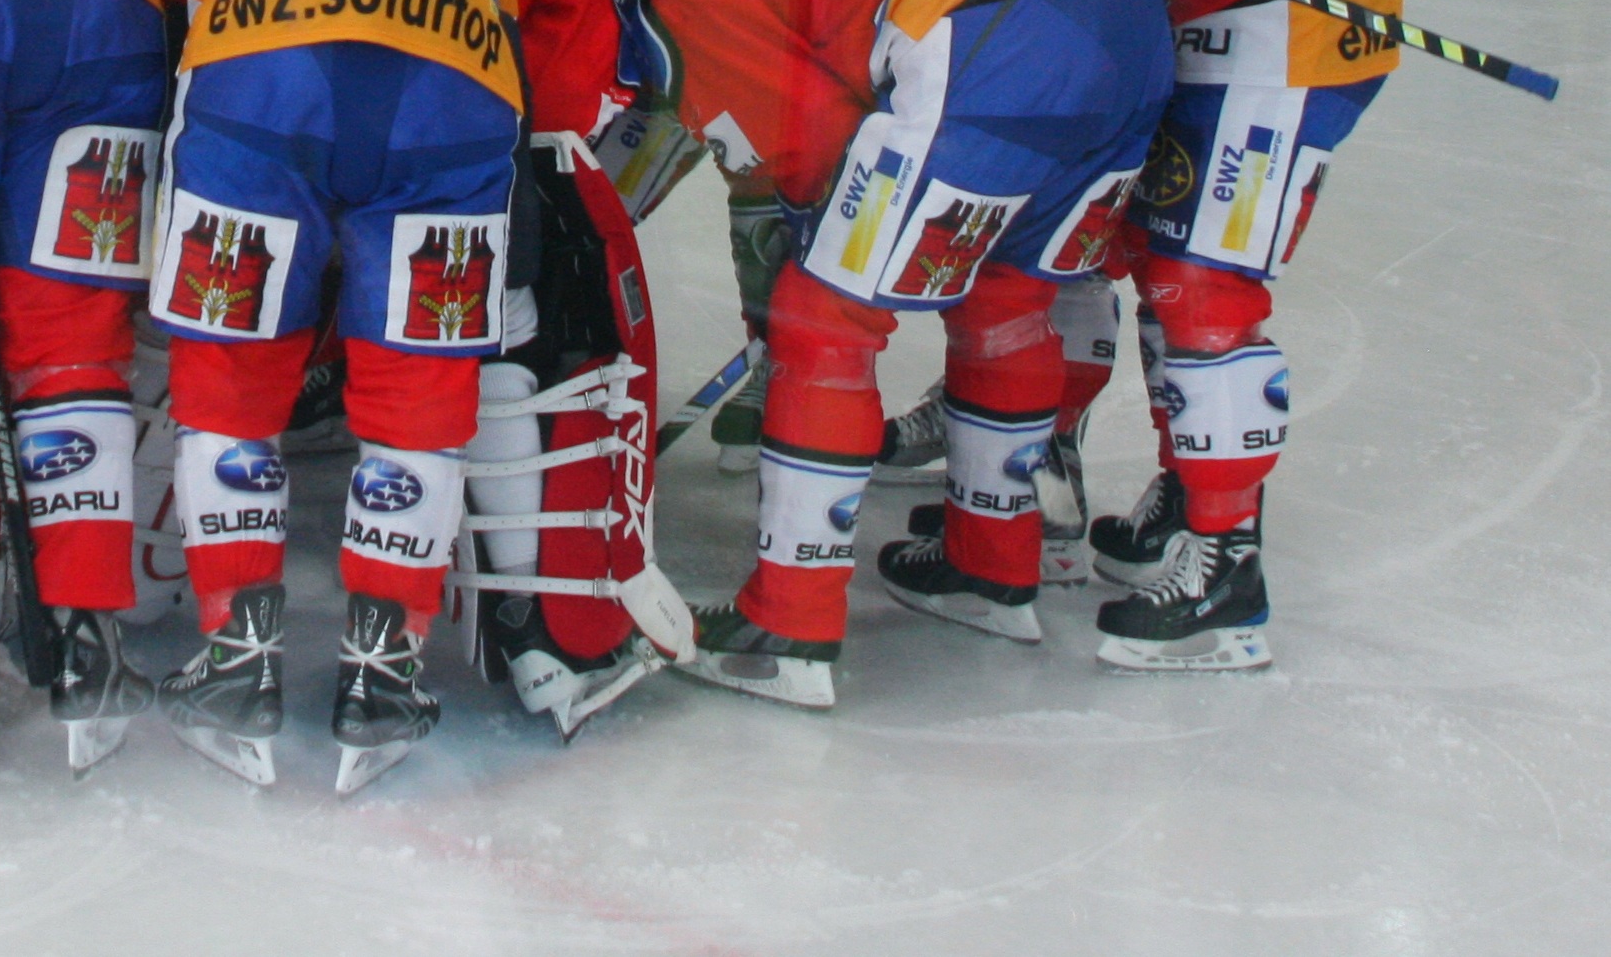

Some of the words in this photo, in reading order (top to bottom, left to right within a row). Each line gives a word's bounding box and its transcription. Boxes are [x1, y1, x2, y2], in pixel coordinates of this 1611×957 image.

[1269, 130, 1283, 165] Energie
[1212, 145, 1246, 203] ewz
[1265, 164, 1276, 181] Die
[840, 161, 874, 220] ewz
[890, 192, 901, 207] Die
